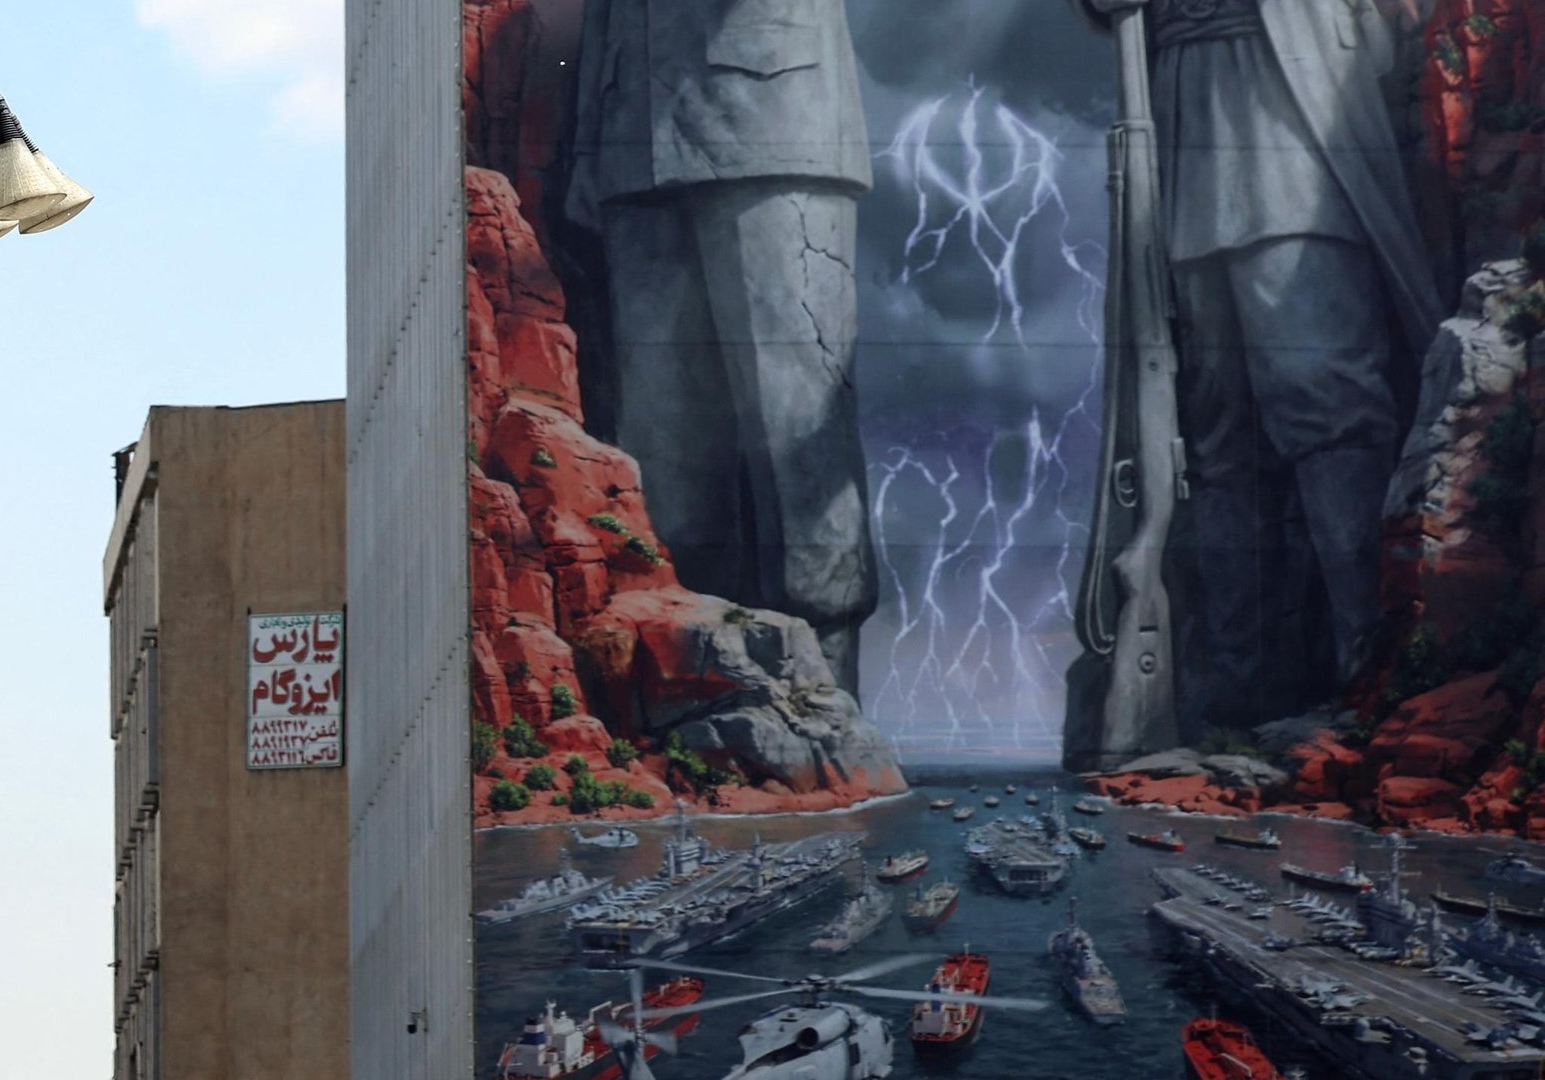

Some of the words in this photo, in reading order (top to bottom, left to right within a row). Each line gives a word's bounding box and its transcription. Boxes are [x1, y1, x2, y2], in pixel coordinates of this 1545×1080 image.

[253, 616, 339, 664] پارس
[253, 668, 341, 716] ایزوگام
[308, 720, 338, 742] تلفن
[306, 743, 338, 765] فاکس
